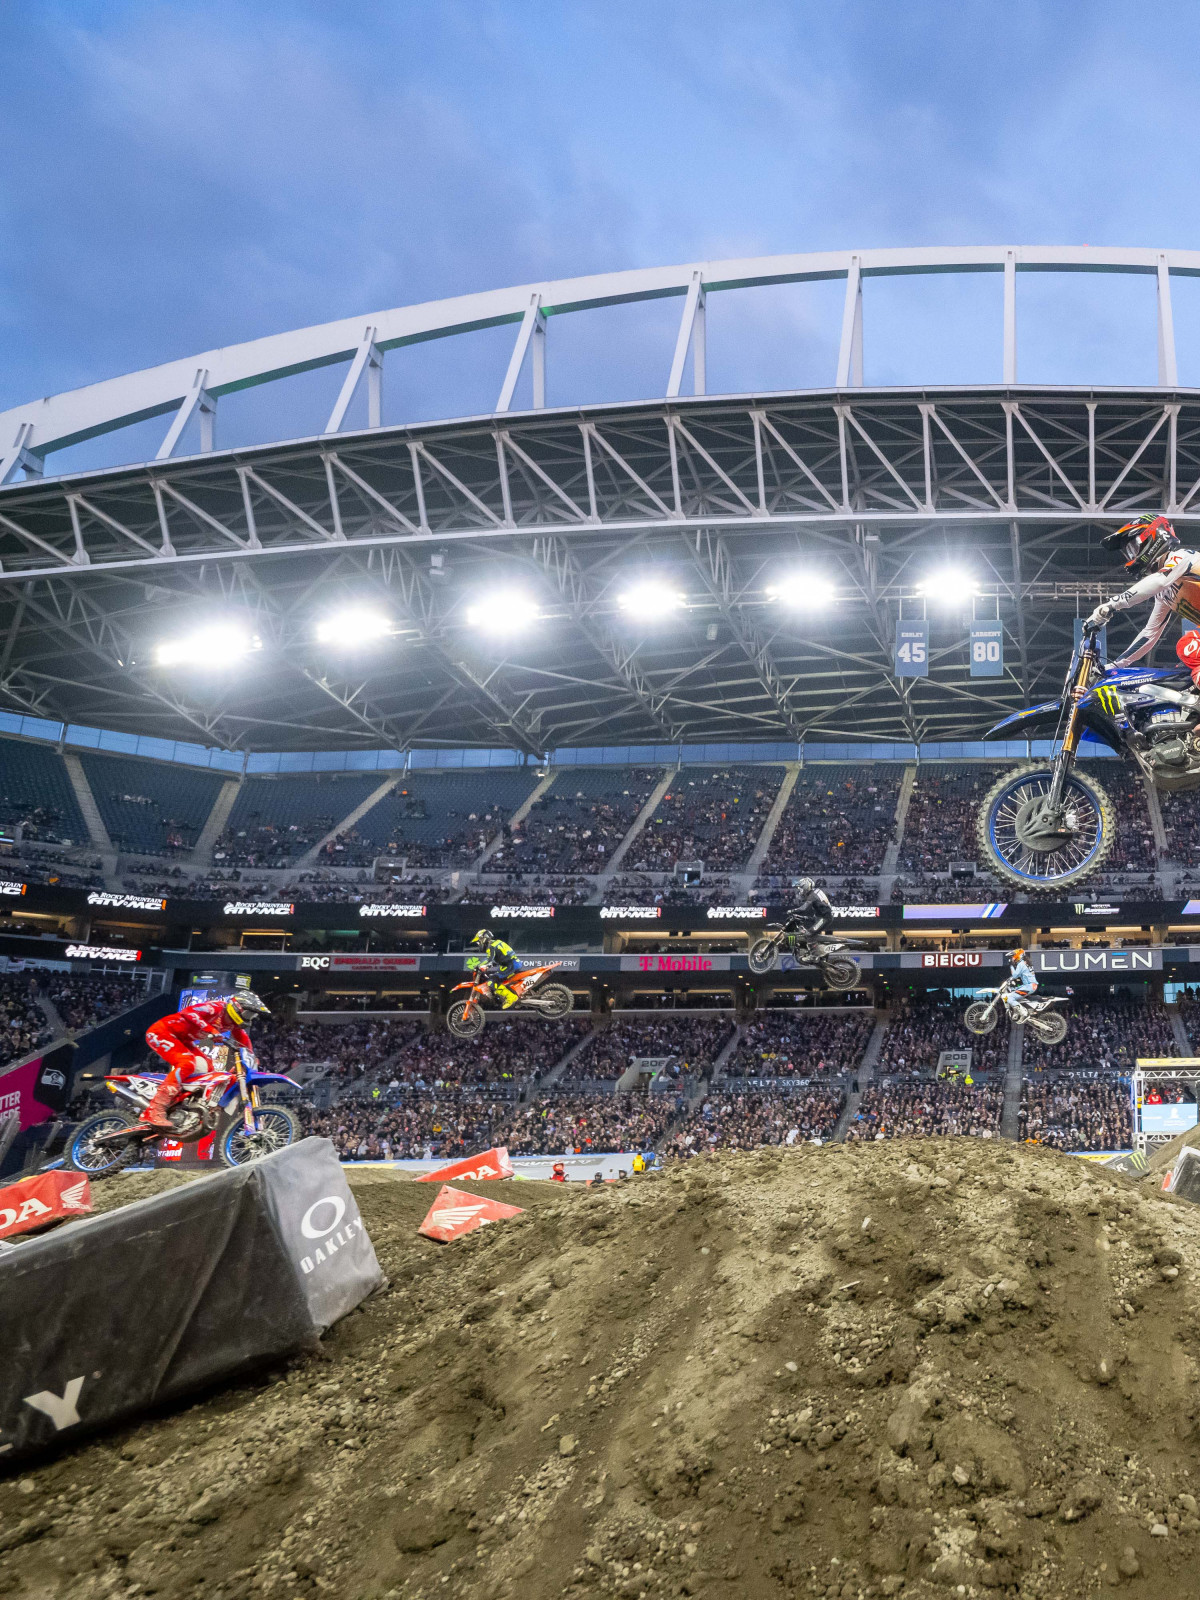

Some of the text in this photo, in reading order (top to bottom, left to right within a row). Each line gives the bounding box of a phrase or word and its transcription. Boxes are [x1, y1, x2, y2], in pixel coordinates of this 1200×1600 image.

[897, 642, 926, 663] 45
[973, 641, 1000, 662] 80
[100, 892, 162, 904] ROCKY MOUNTAIN
[302, 956, 330, 970] EQC
[658, 956, 712, 971] Mobile
[1041, 951, 1153, 970] LUMEN
[305, 1065, 324, 1073] 20
[62, 1202, 91, 1210] HONDA
[300, 1216, 364, 1274] OAKLEY
